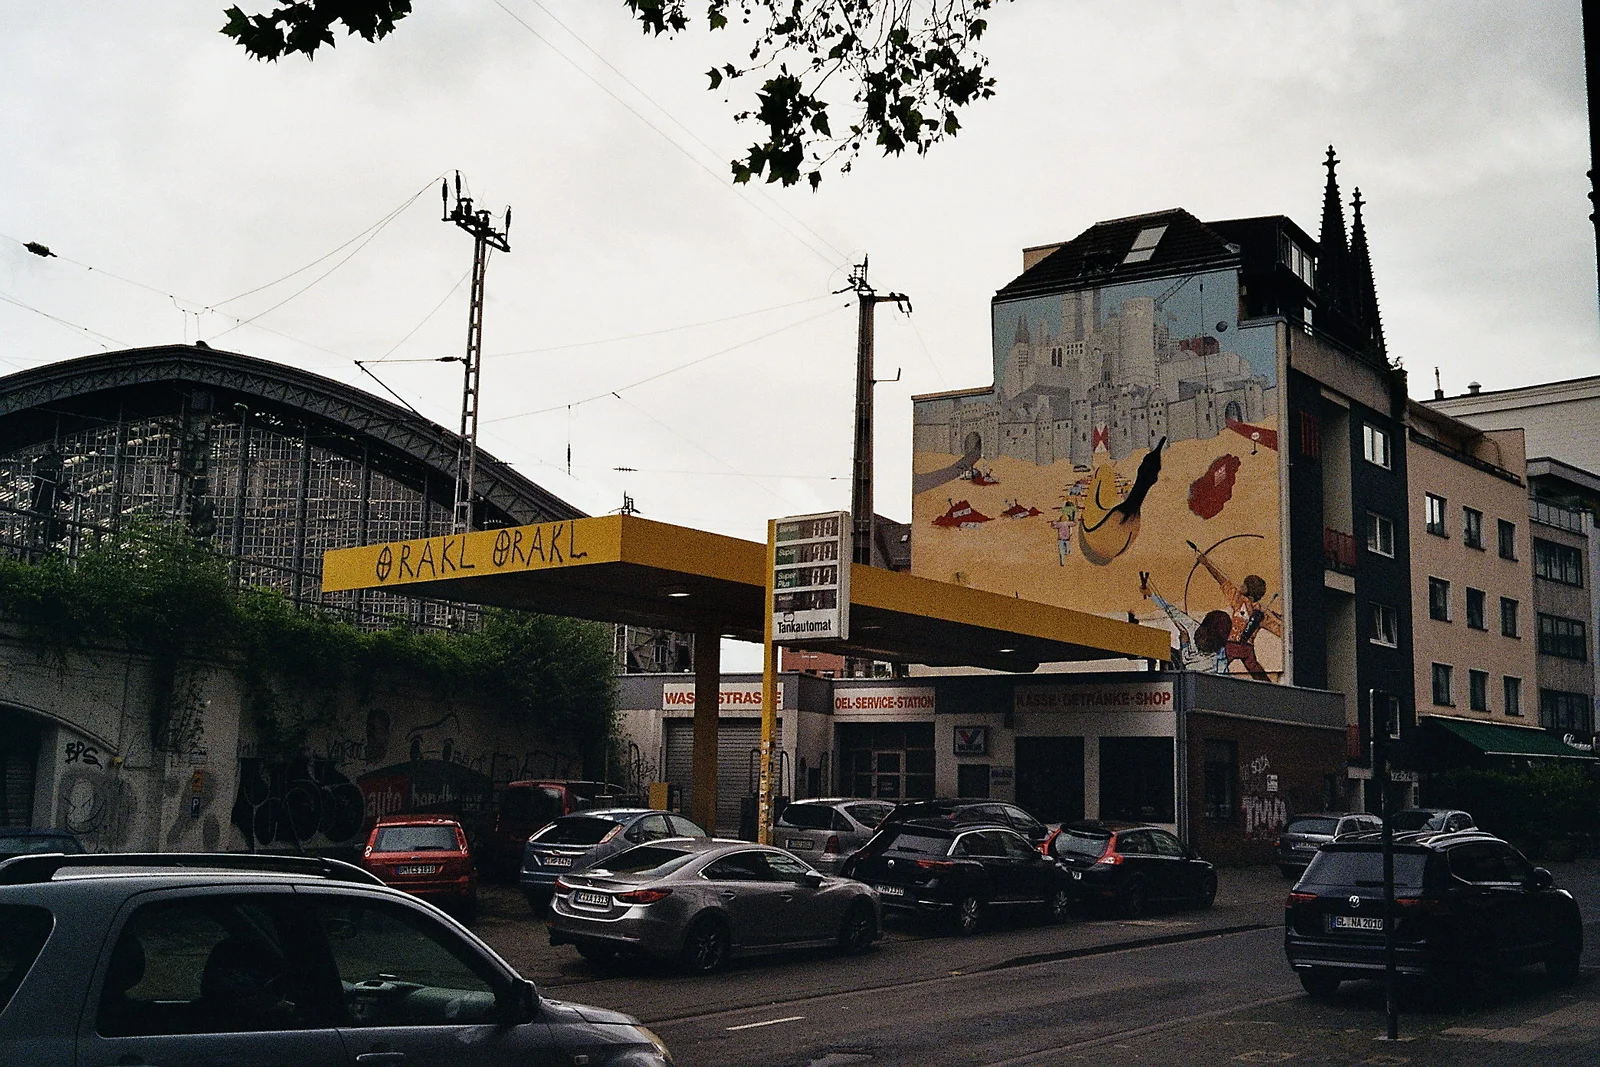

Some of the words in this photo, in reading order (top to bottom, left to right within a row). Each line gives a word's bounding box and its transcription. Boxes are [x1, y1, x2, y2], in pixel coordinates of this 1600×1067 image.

[777, 620, 832, 634] Tankautomat
[1336, 916, 1347, 927] GL
[1351, 917, 1362, 927] NA
[1363, 918, 1384, 929] 2010
